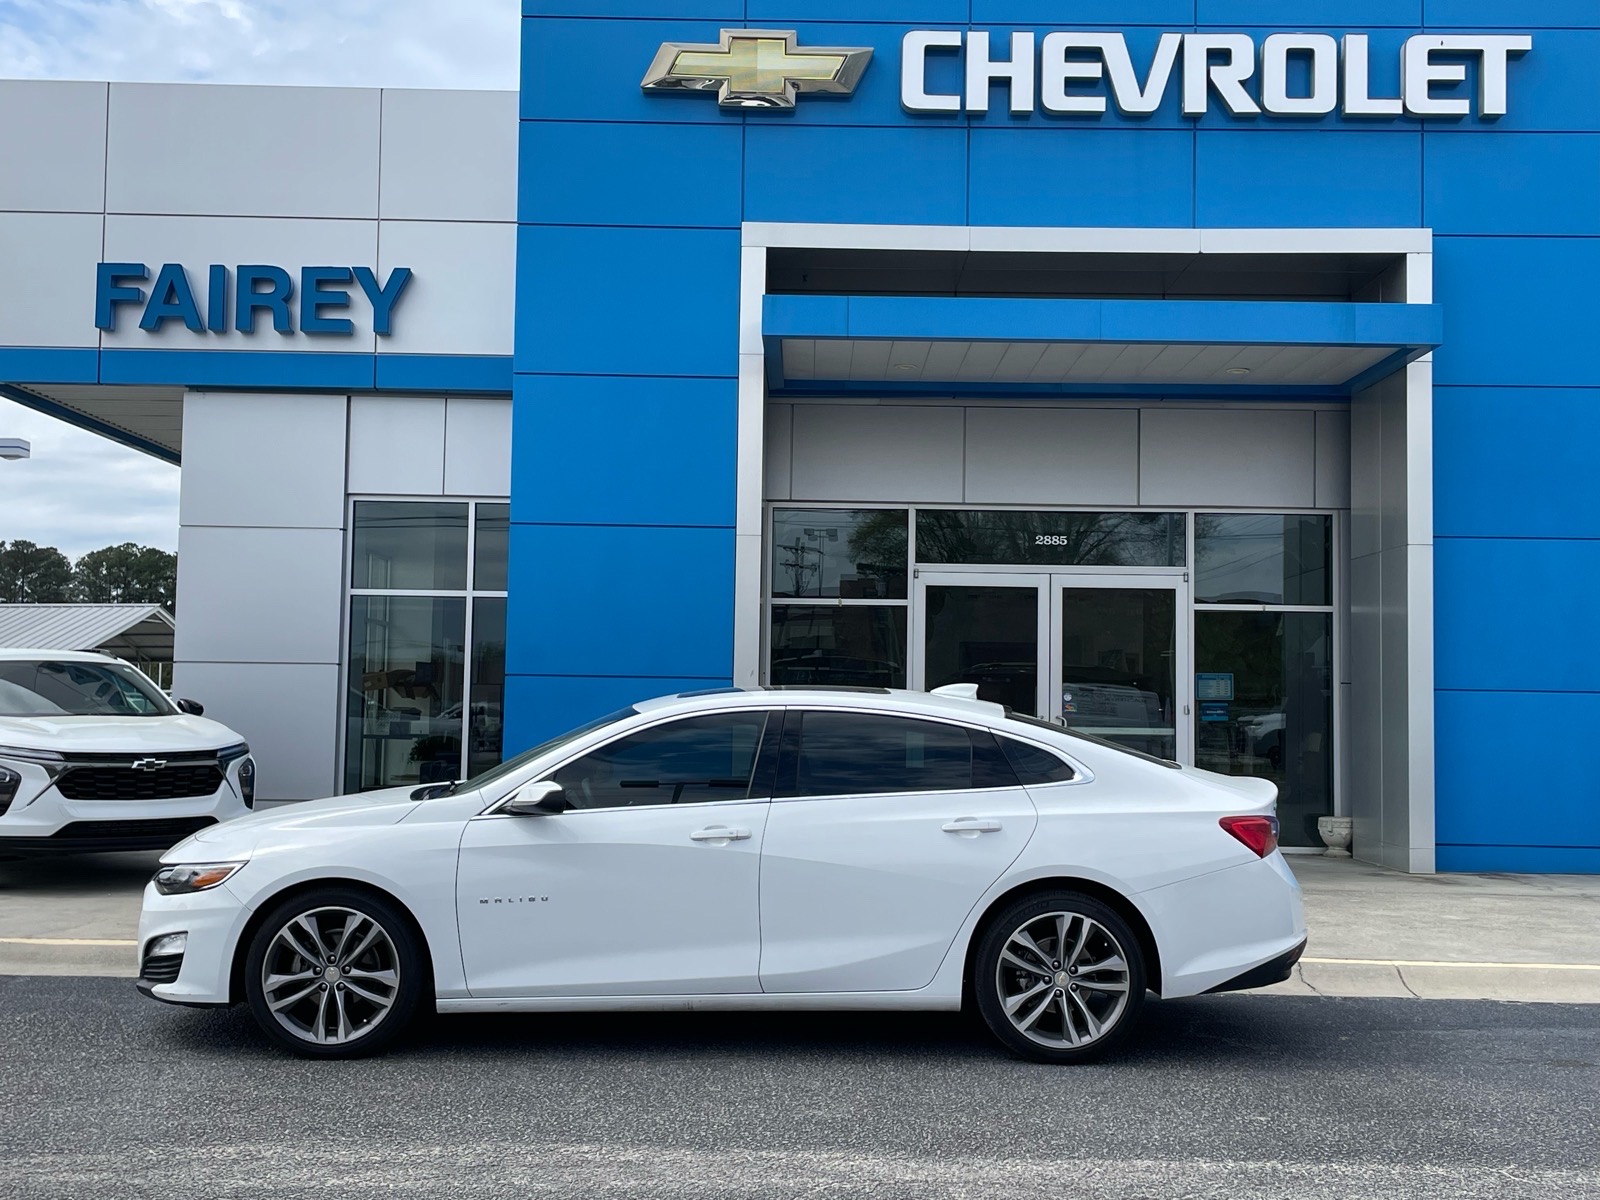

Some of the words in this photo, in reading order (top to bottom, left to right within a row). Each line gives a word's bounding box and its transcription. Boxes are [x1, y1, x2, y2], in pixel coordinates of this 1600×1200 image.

[901, 30, 1532, 117] CHEVROLET
[95, 262, 413, 336] FAIREY
[1035, 534, 1068, 546] 2885
[479, 896, 549, 904] MALIBU
